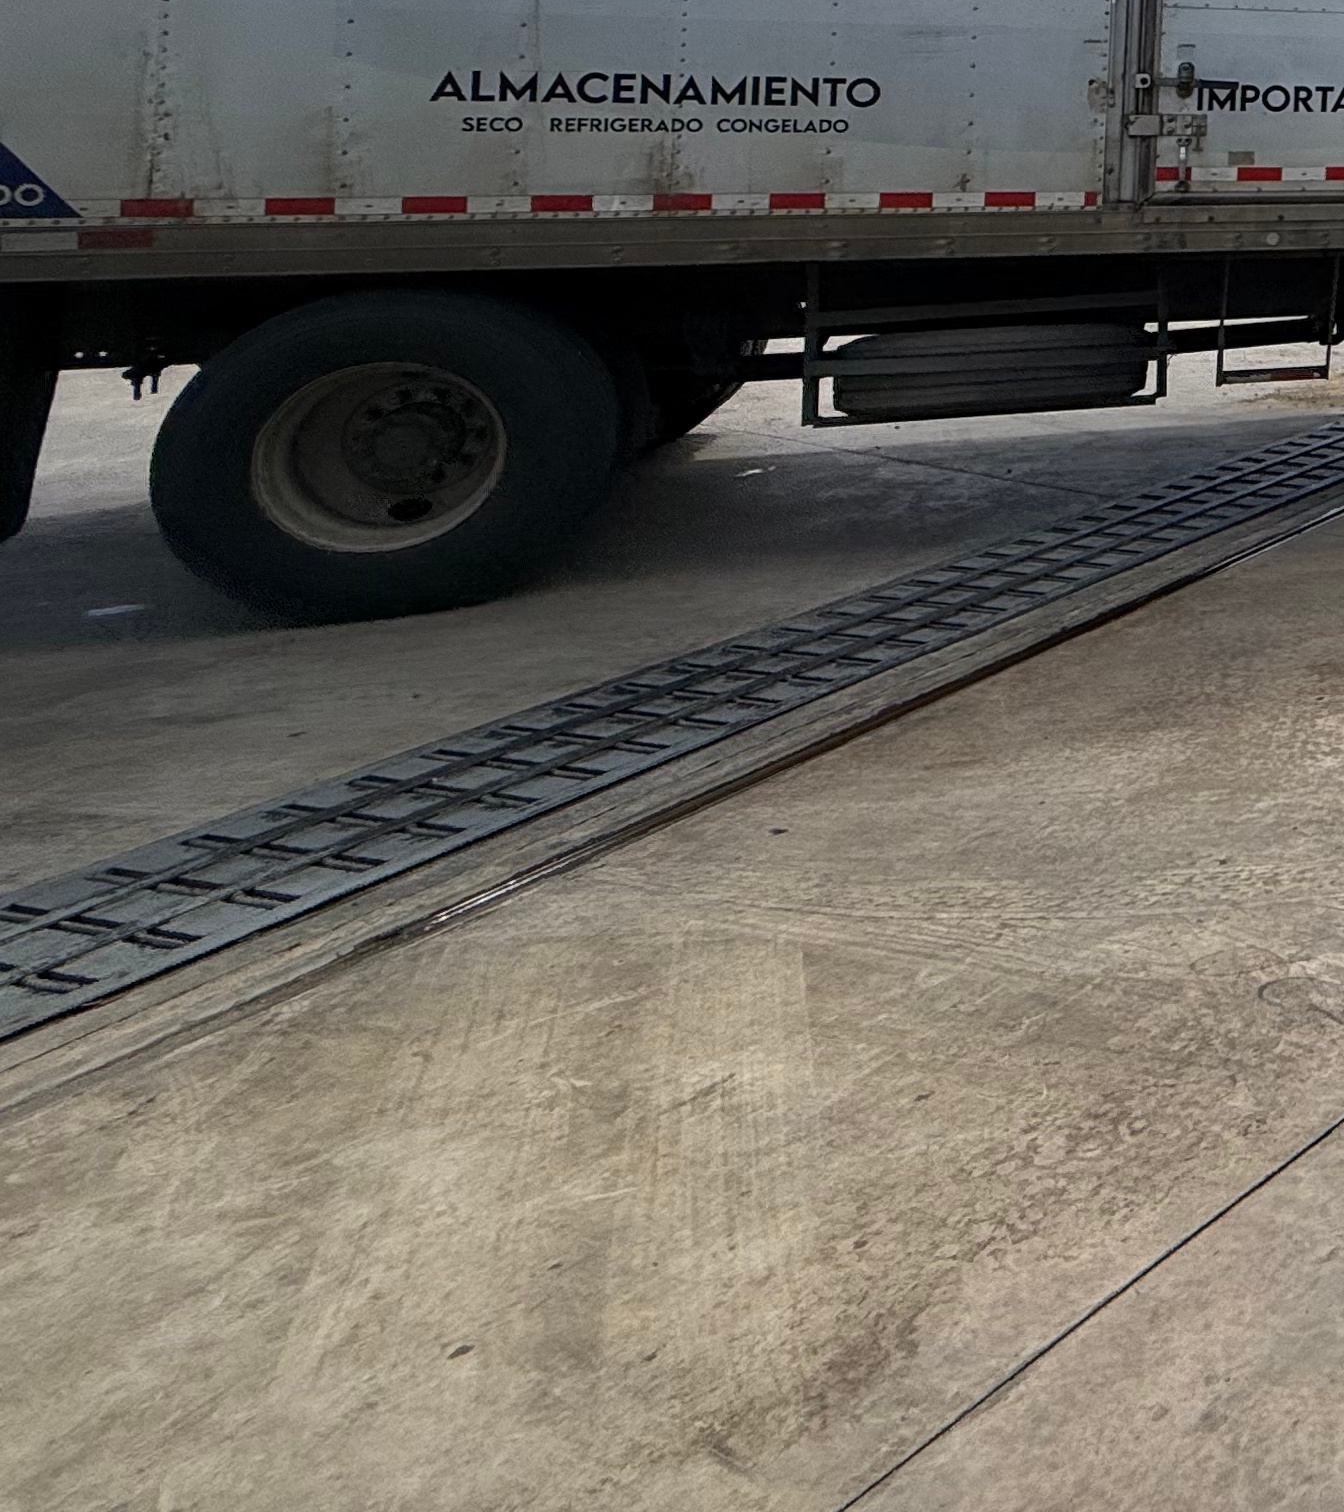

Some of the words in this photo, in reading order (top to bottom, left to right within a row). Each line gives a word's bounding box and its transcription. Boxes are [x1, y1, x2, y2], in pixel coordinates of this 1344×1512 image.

[429, 70, 882, 108] ALMACENAMIENTO
[461, 116, 523, 133] SECO
[549, 117, 704, 133] REFRIGERADO
[716, 118, 849, 134] CONGELADO
